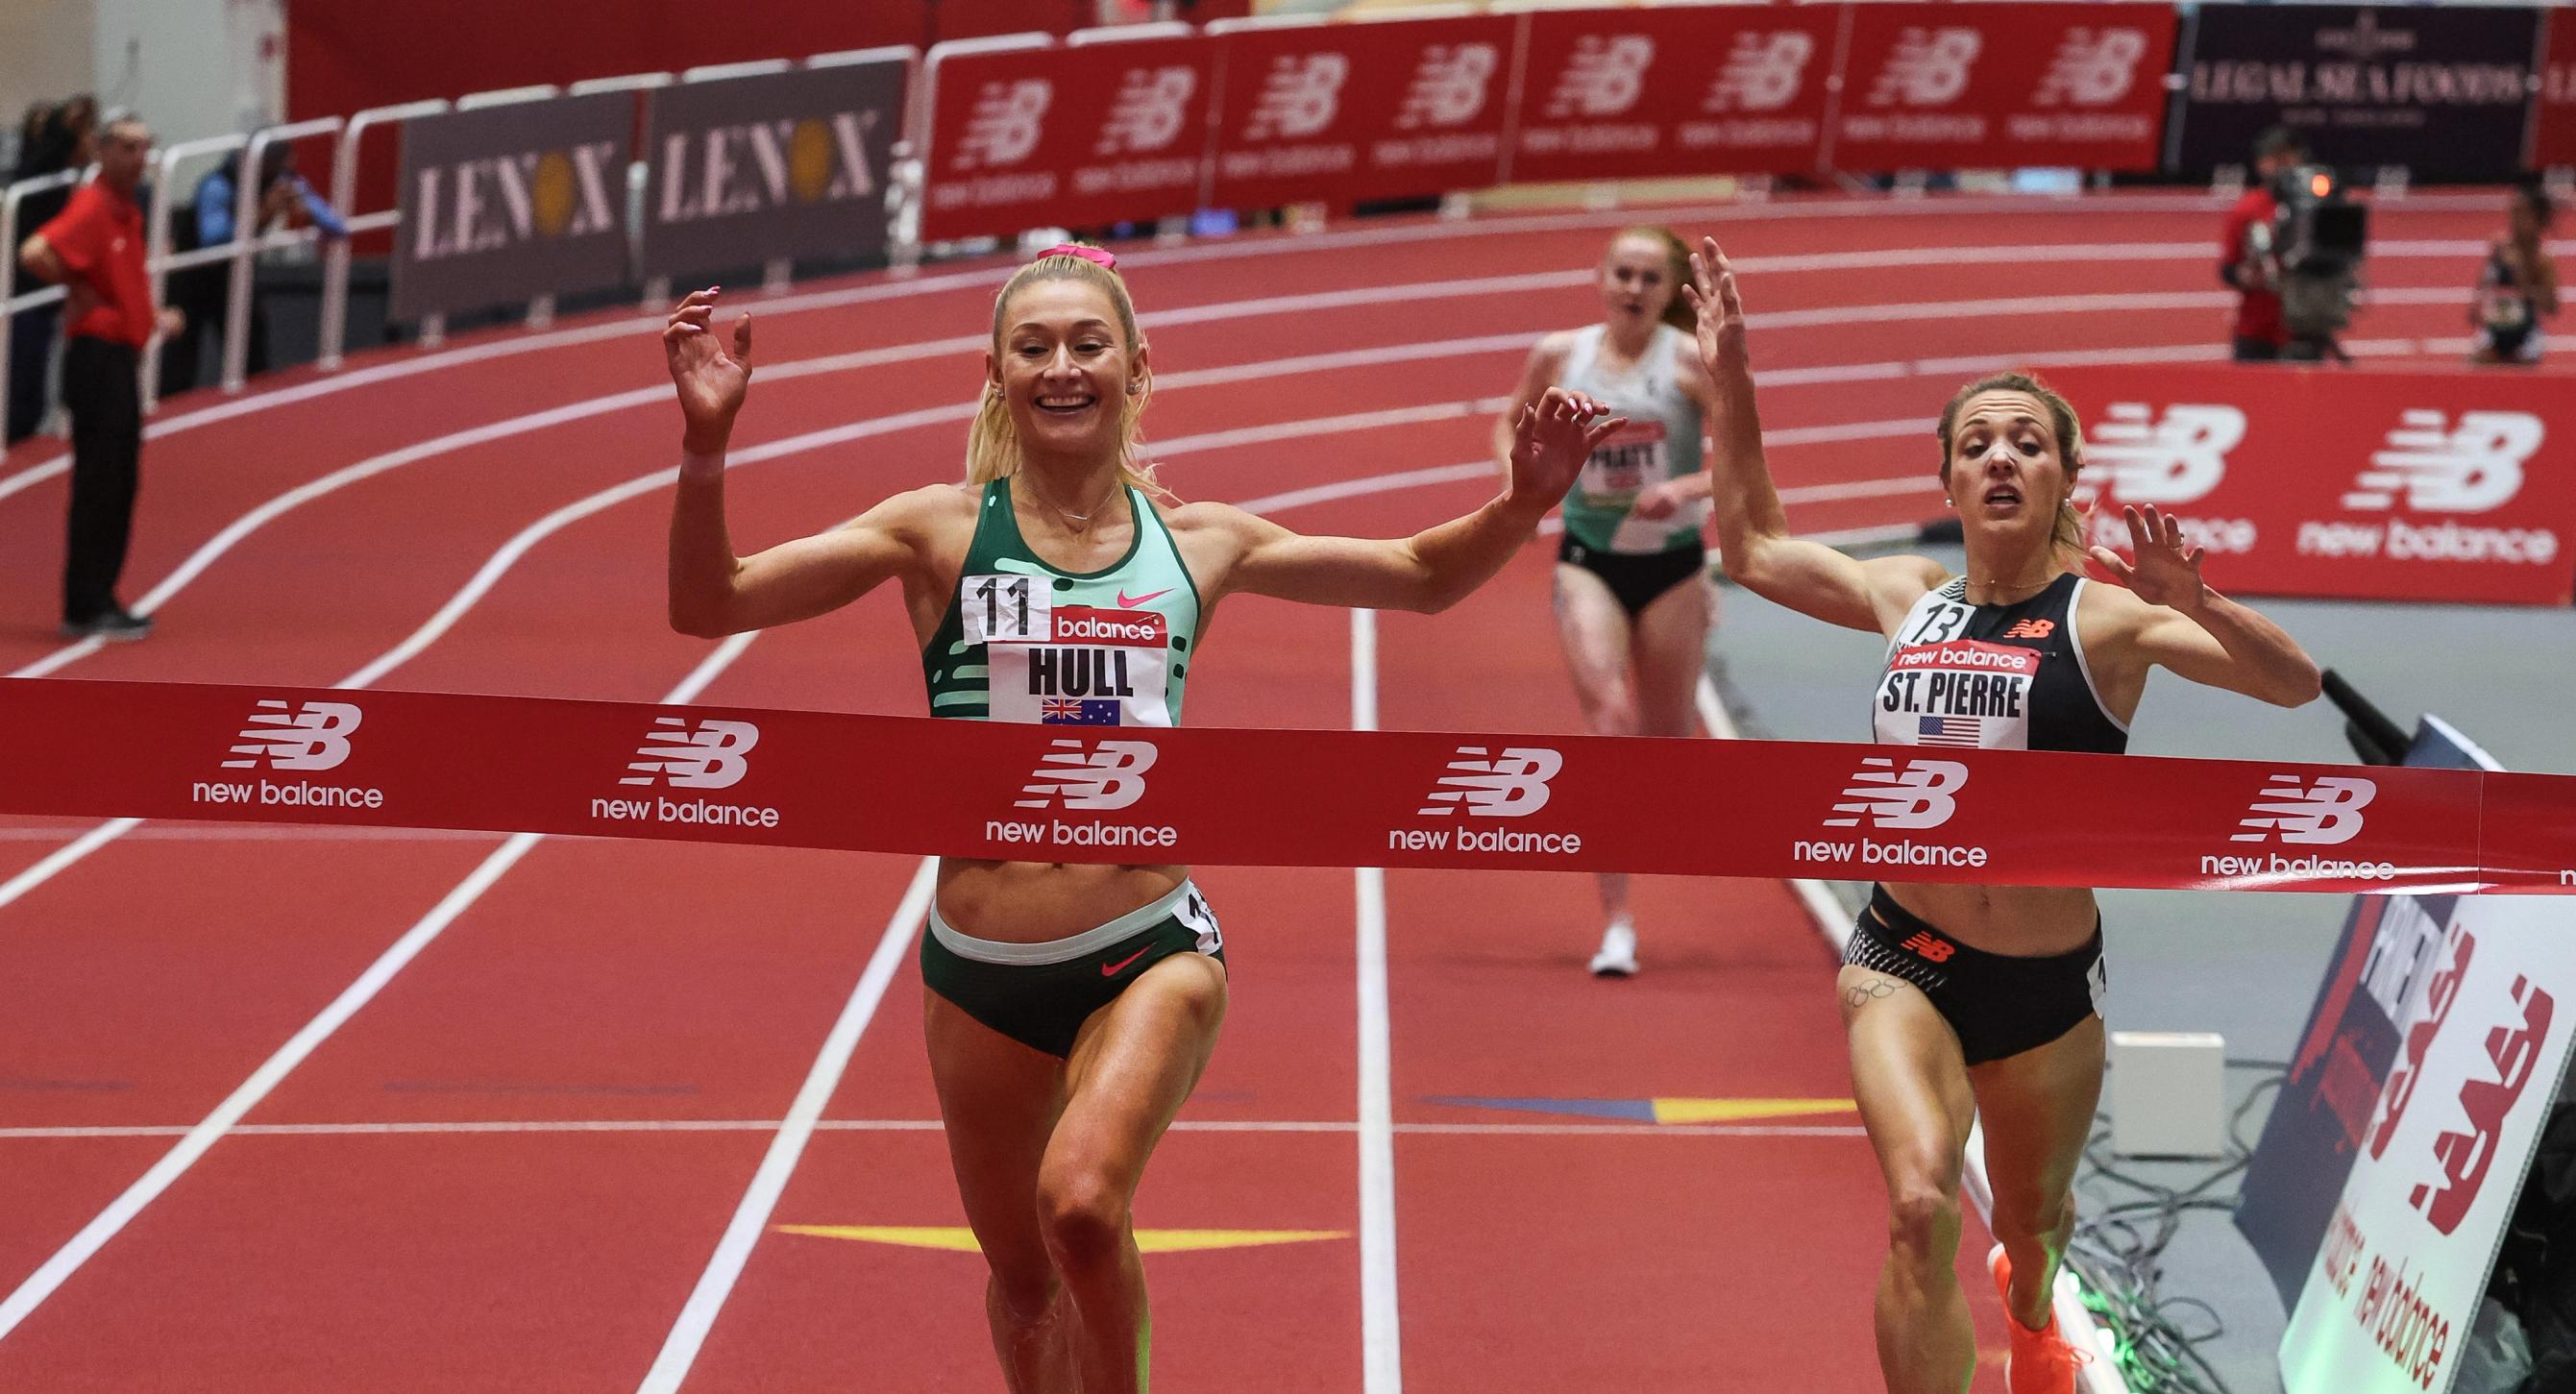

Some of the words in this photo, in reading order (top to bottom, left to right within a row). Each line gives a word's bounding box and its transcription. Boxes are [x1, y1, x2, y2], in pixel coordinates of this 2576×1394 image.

[659, 110, 880, 222] LENOX
[414, 141, 615, 259] LENOX
[2296, 521, 2383, 555] new
[2387, 517, 2558, 565] balance
[975, 577, 1029, 636] 11
[1910, 602, 1965, 644] 13
[1057, 616, 1156, 640] balance
[1028, 648, 1134, 697] HULL
[1898, 650, 1938, 667] new
[1940, 648, 2026, 670] balance
[1882, 672, 1920, 714] ST.
[1926, 672, 2023, 719] PIERRE
[193, 779, 254, 804] new
[260, 779, 383, 809] balance
[591, 795, 651, 821] new
[658, 797, 779, 828] balance
[986, 818, 1045, 844] new
[1053, 819, 1177, 847] balance
[1388, 826, 1450, 851] new
[1457, 825, 1581, 854] balance
[1794, 840, 1855, 863] new
[1862, 838, 1987, 868] balance
[2201, 854, 2262, 876] new
[2270, 853, 2395, 881] balance
